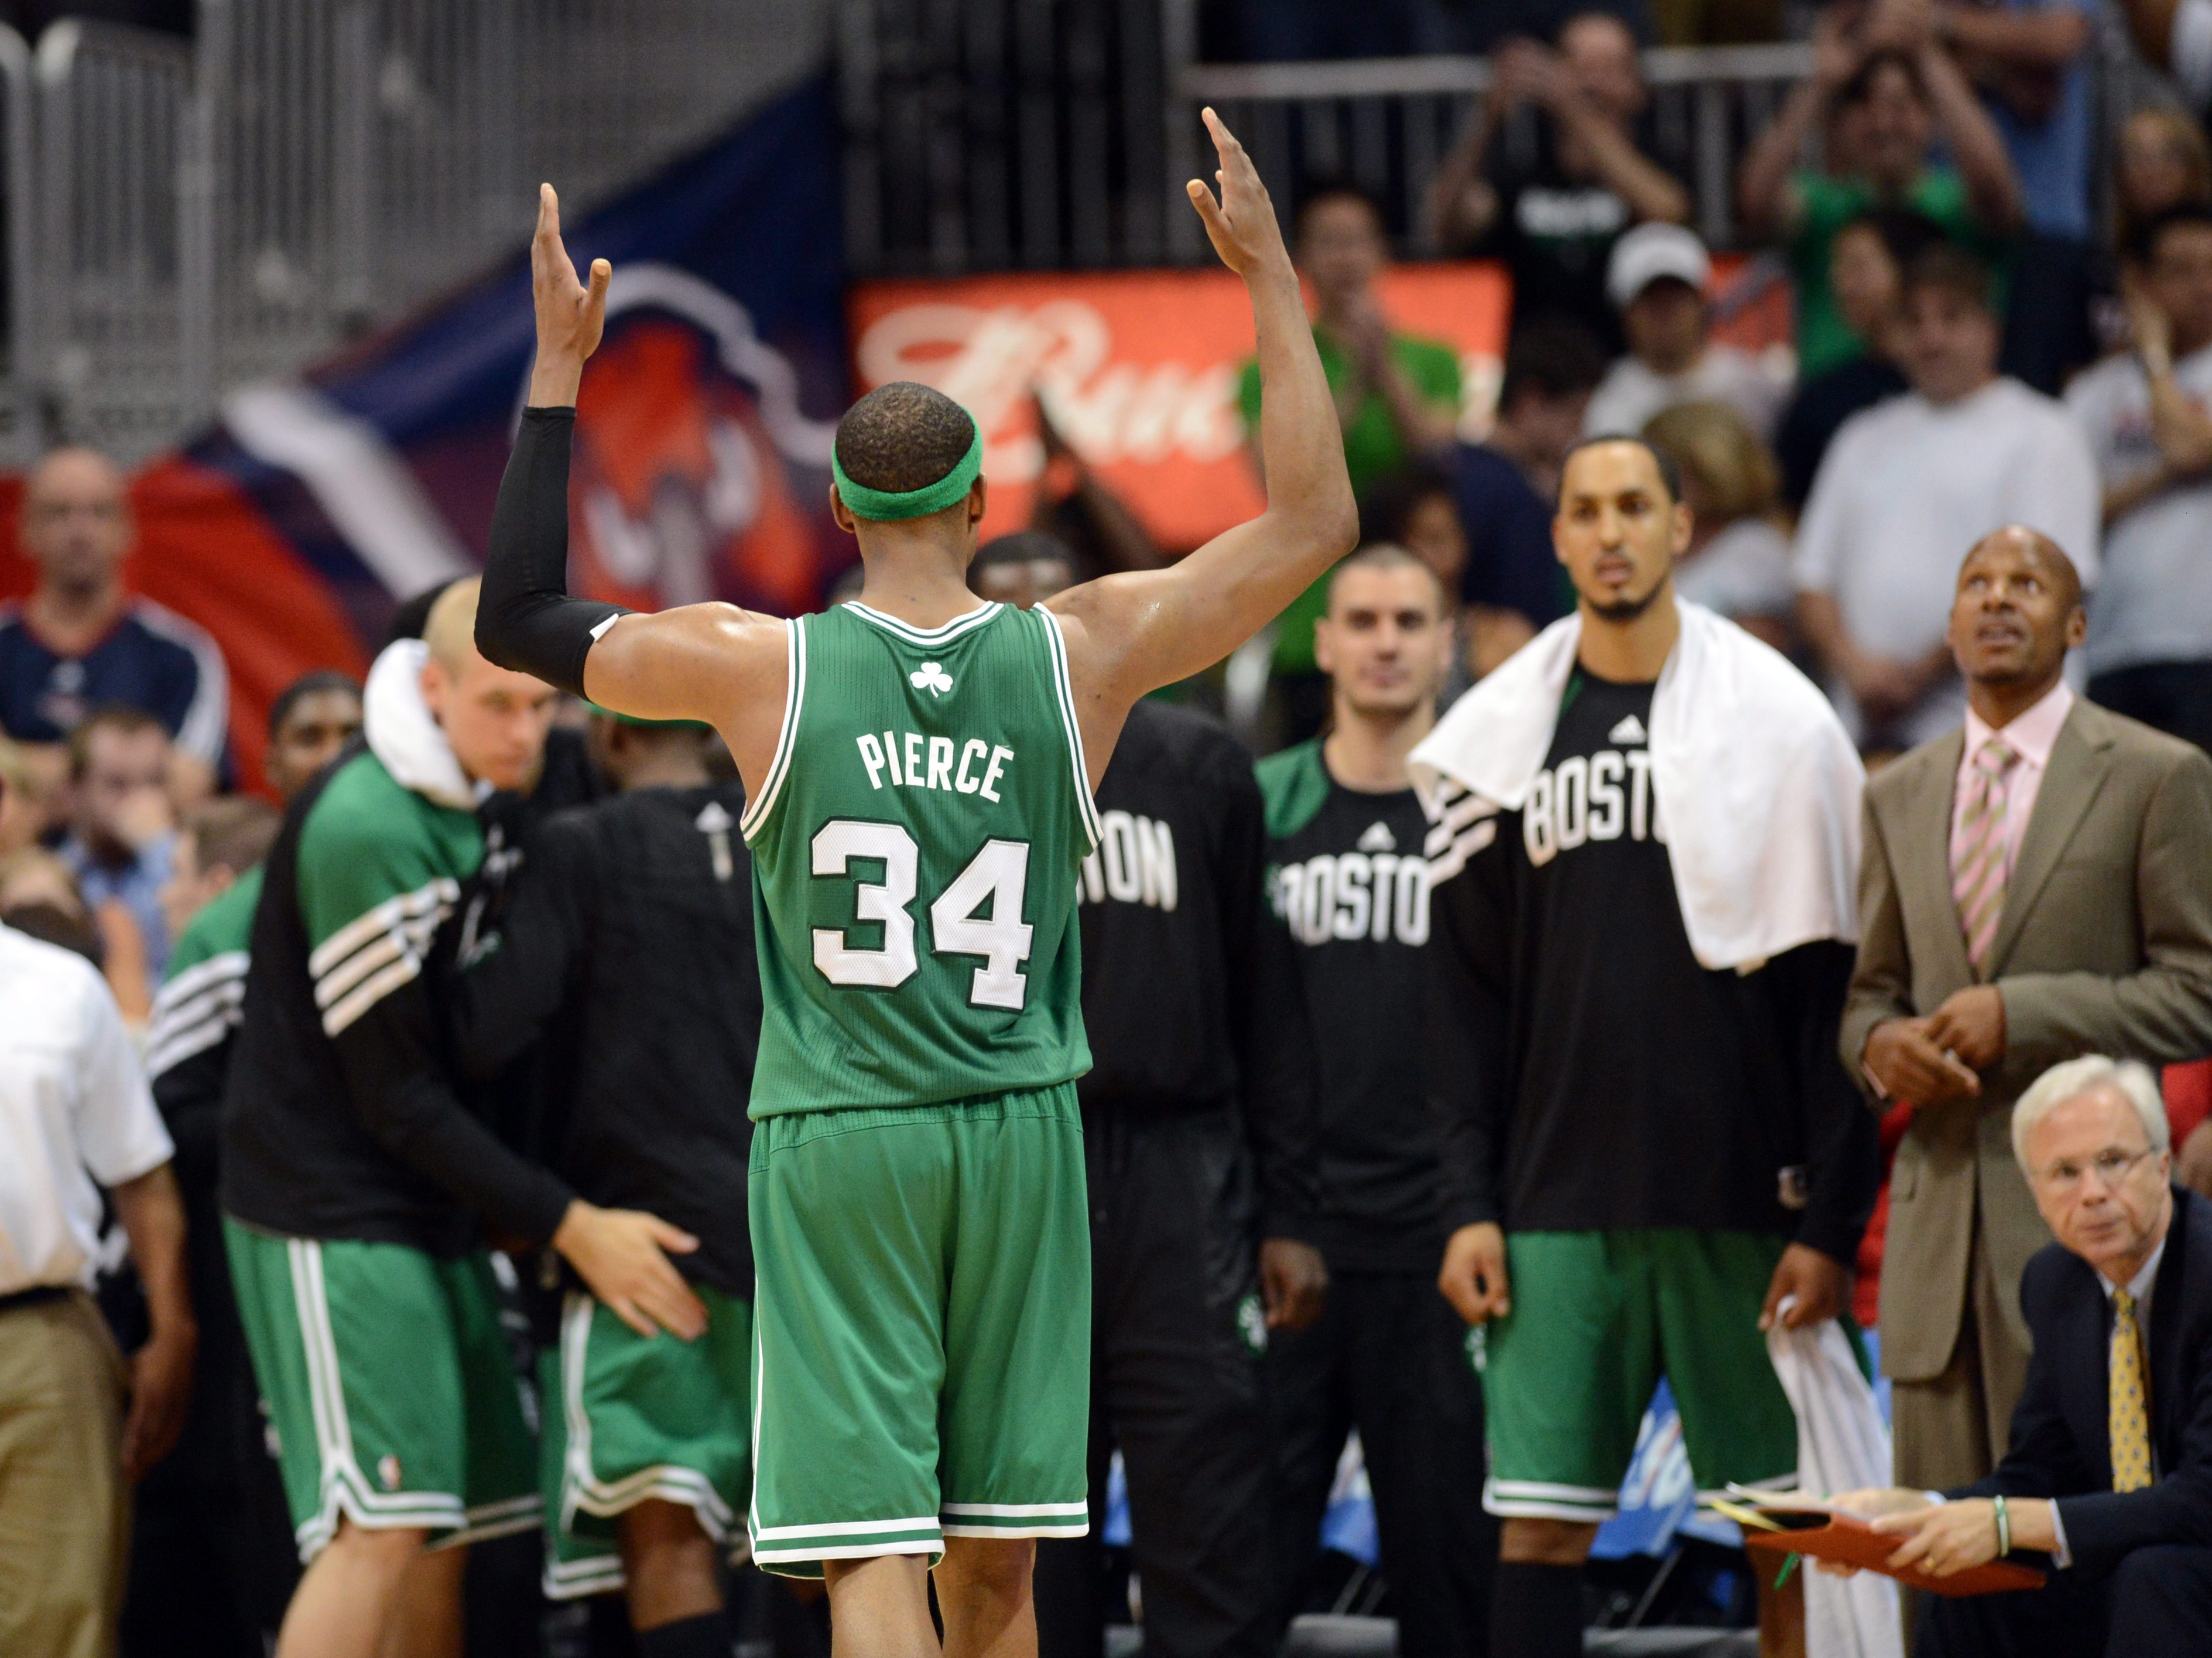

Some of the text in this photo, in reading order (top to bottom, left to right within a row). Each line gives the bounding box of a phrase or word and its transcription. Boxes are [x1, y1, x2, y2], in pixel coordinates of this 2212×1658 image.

[856, 730, 1014, 803] PIERCE
[1523, 750, 1667, 868] BOST
[809, 816, 1033, 1015] 34
